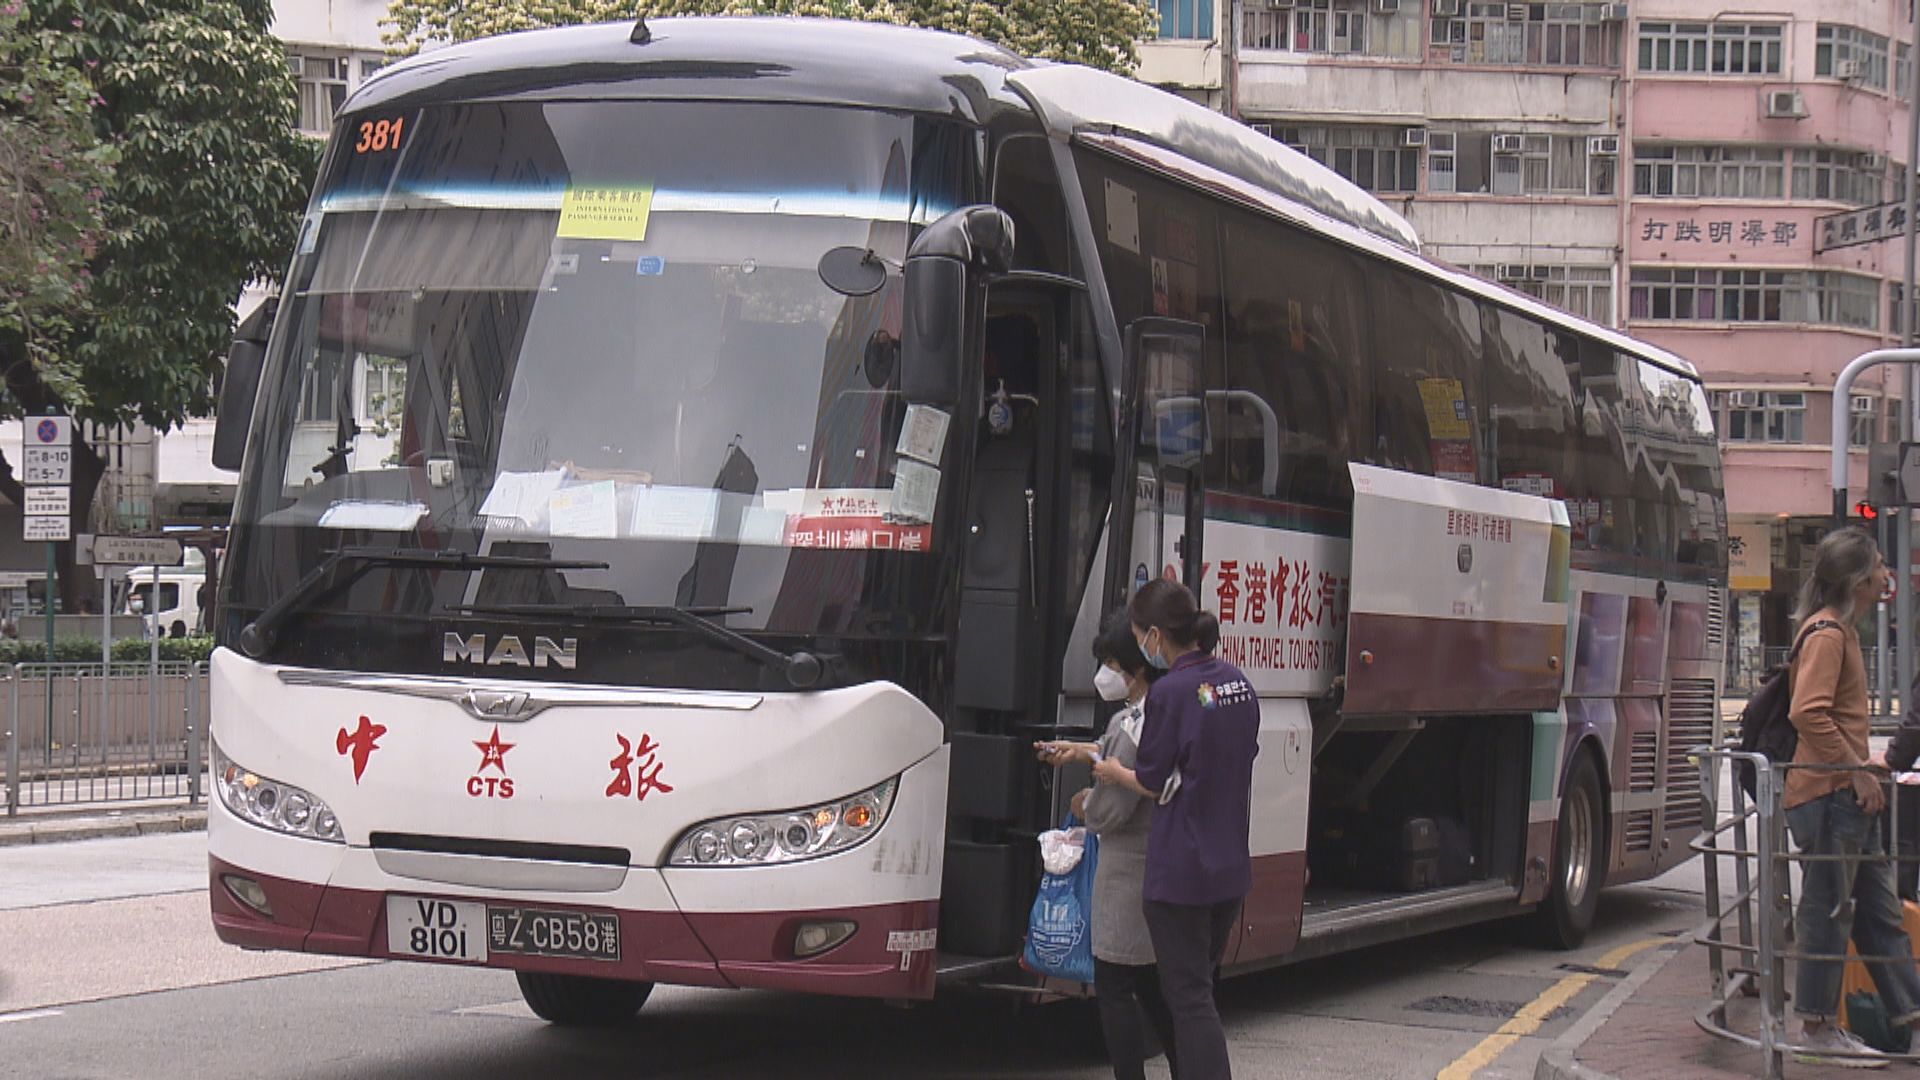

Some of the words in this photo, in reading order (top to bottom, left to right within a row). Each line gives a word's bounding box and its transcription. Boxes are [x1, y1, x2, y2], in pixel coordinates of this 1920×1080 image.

[356, 117, 404, 154] 381
[41, 452, 69, 463] 8-10
[42, 469, 64, 479] 5-7
[443, 632, 578, 669] MAN
[1249, 637, 1285, 670] TRAVEL
[1288, 640, 1320, 670] TOURS
[336, 715, 388, 786] 中
[605, 731, 674, 803] 旅
[466, 775, 515, 800] CTS
[416, 900, 458, 929] VD
[410, 927, 467, 958] 8101
